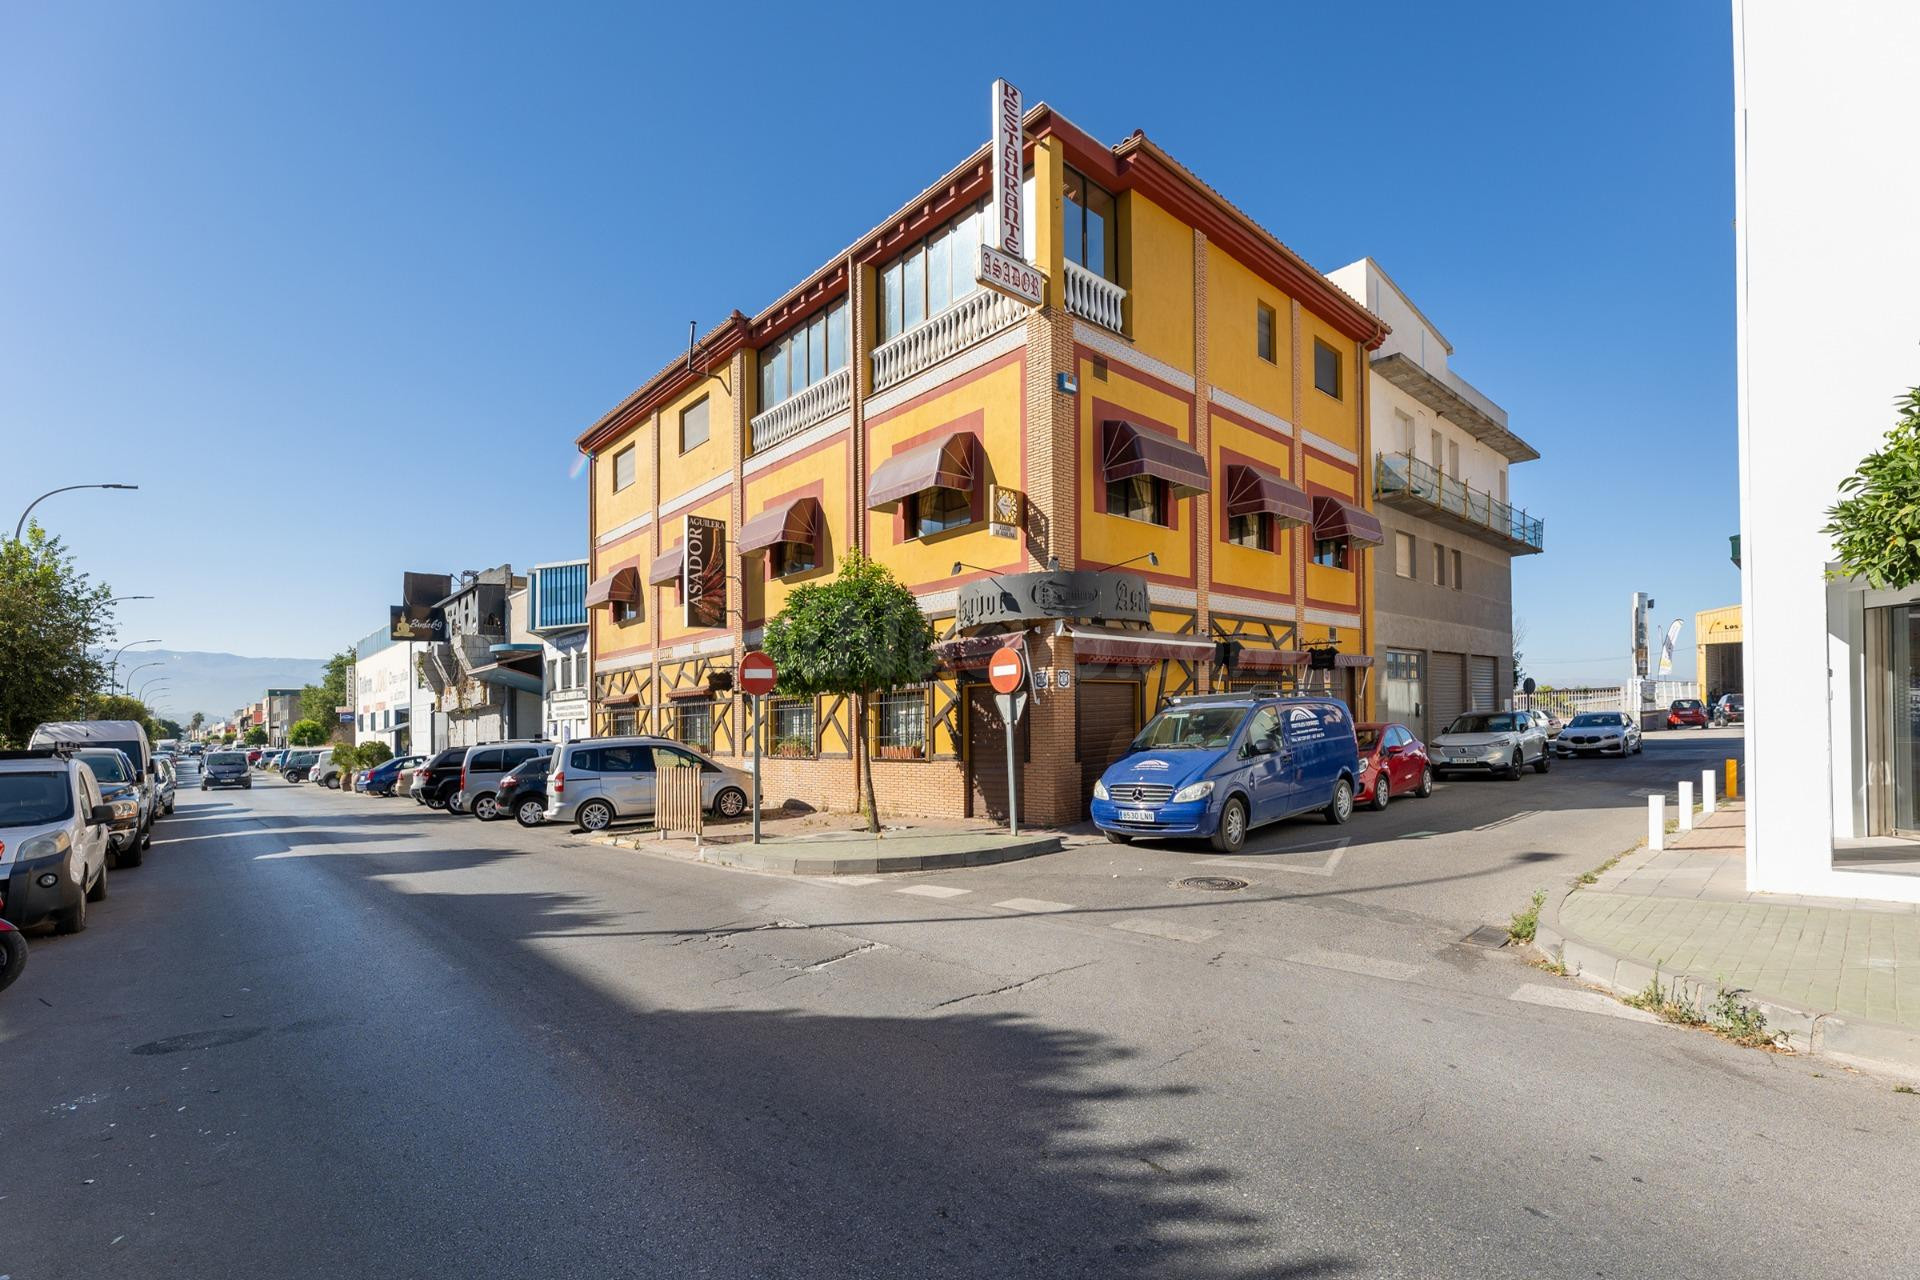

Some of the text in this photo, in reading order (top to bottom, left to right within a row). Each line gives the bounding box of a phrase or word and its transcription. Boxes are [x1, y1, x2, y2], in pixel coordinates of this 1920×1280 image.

[1003, 83, 1019, 255] RESTAURANTE
[982, 252, 1040, 298] ASADOR
[689, 517, 725, 529] AGUILERA
[689, 527, 703, 609] ASADOR
[1123, 811, 1153, 820] 8530 LNN
